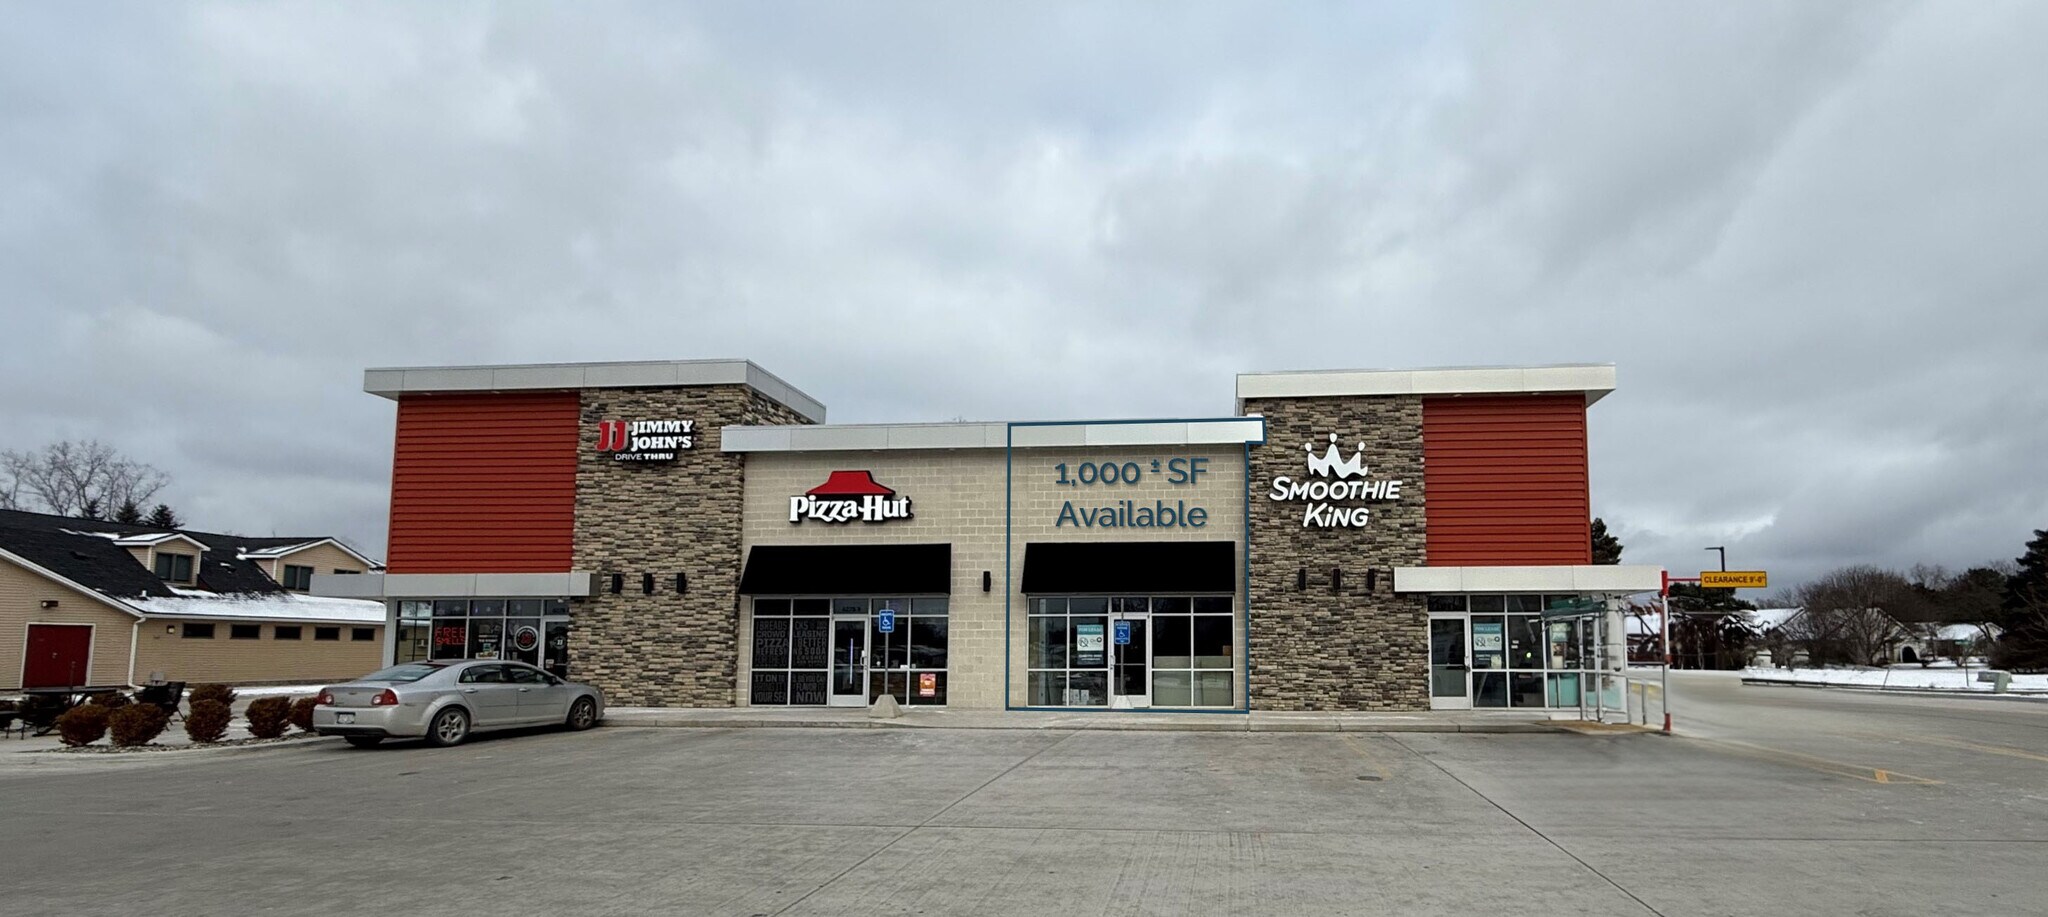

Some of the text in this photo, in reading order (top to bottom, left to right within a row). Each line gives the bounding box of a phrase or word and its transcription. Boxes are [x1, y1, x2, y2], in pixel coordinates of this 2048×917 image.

[631, 420, 693, 436] JIMMY
[631, 436, 692, 452] JOHN'S
[1269, 476, 1403, 501] SMOOTHIE
[789, 495, 909, 522] Pizza Hut
[1703, 576, 1748, 584] CLEARANCE
[435, 627, 466, 637] FREE
[756, 638, 789, 648] PIZZA
